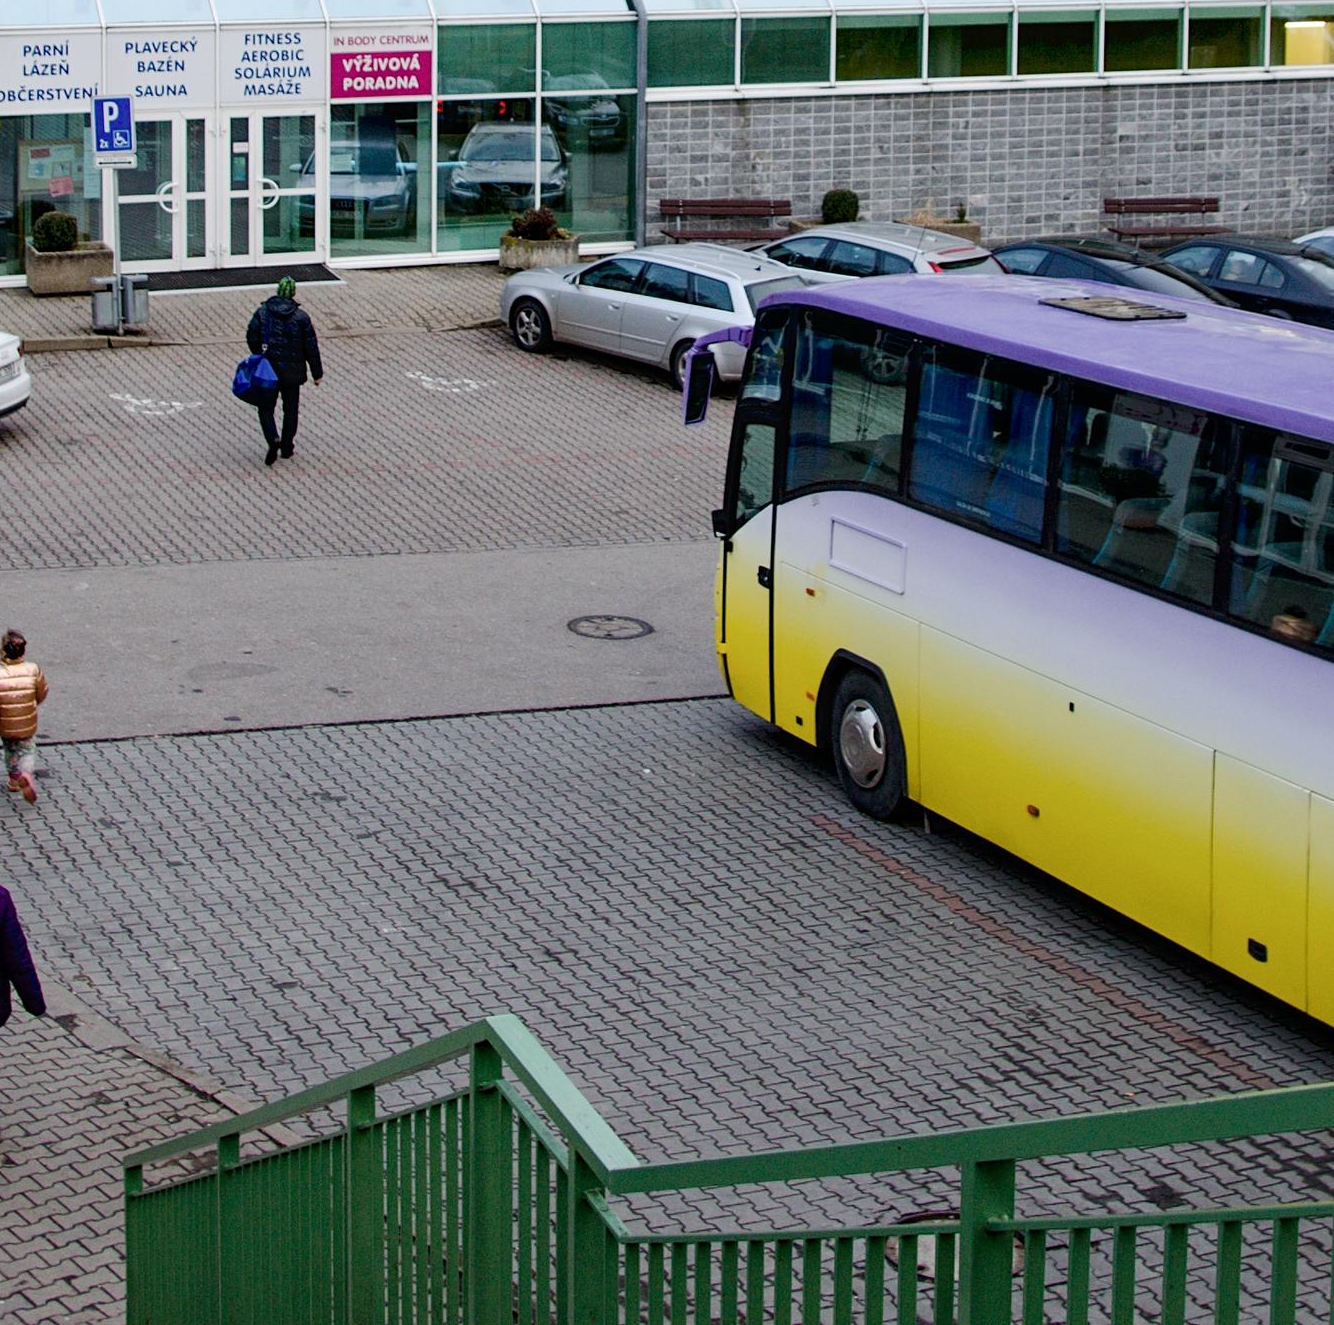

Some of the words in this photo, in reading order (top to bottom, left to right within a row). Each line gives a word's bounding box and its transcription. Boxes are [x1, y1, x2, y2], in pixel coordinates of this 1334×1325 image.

[125, 36, 198, 54] PLAVECKÝ
[244, 32, 302, 46] FITNESS
[334, 37, 345, 46] IN
[348, 36, 377, 46] BODY
[380, 35, 429, 44] CENTRUM
[23, 40, 69, 57] PARNÍ
[241, 49, 304, 62] AEROBIC
[23, 59, 69, 76] LÁZEŇ
[137, 56, 185, 73] BAZÉN
[342, 53, 421, 72] VÝŽIVOVÁ
[234, 63, 312, 79] SOLÁRIUM
[135, 84, 188, 97] SAUNA
[244, 80, 302, 96] MASÁŽE
[343, 75, 419, 91] PORADNA
[103, 101, 119, 133] P
